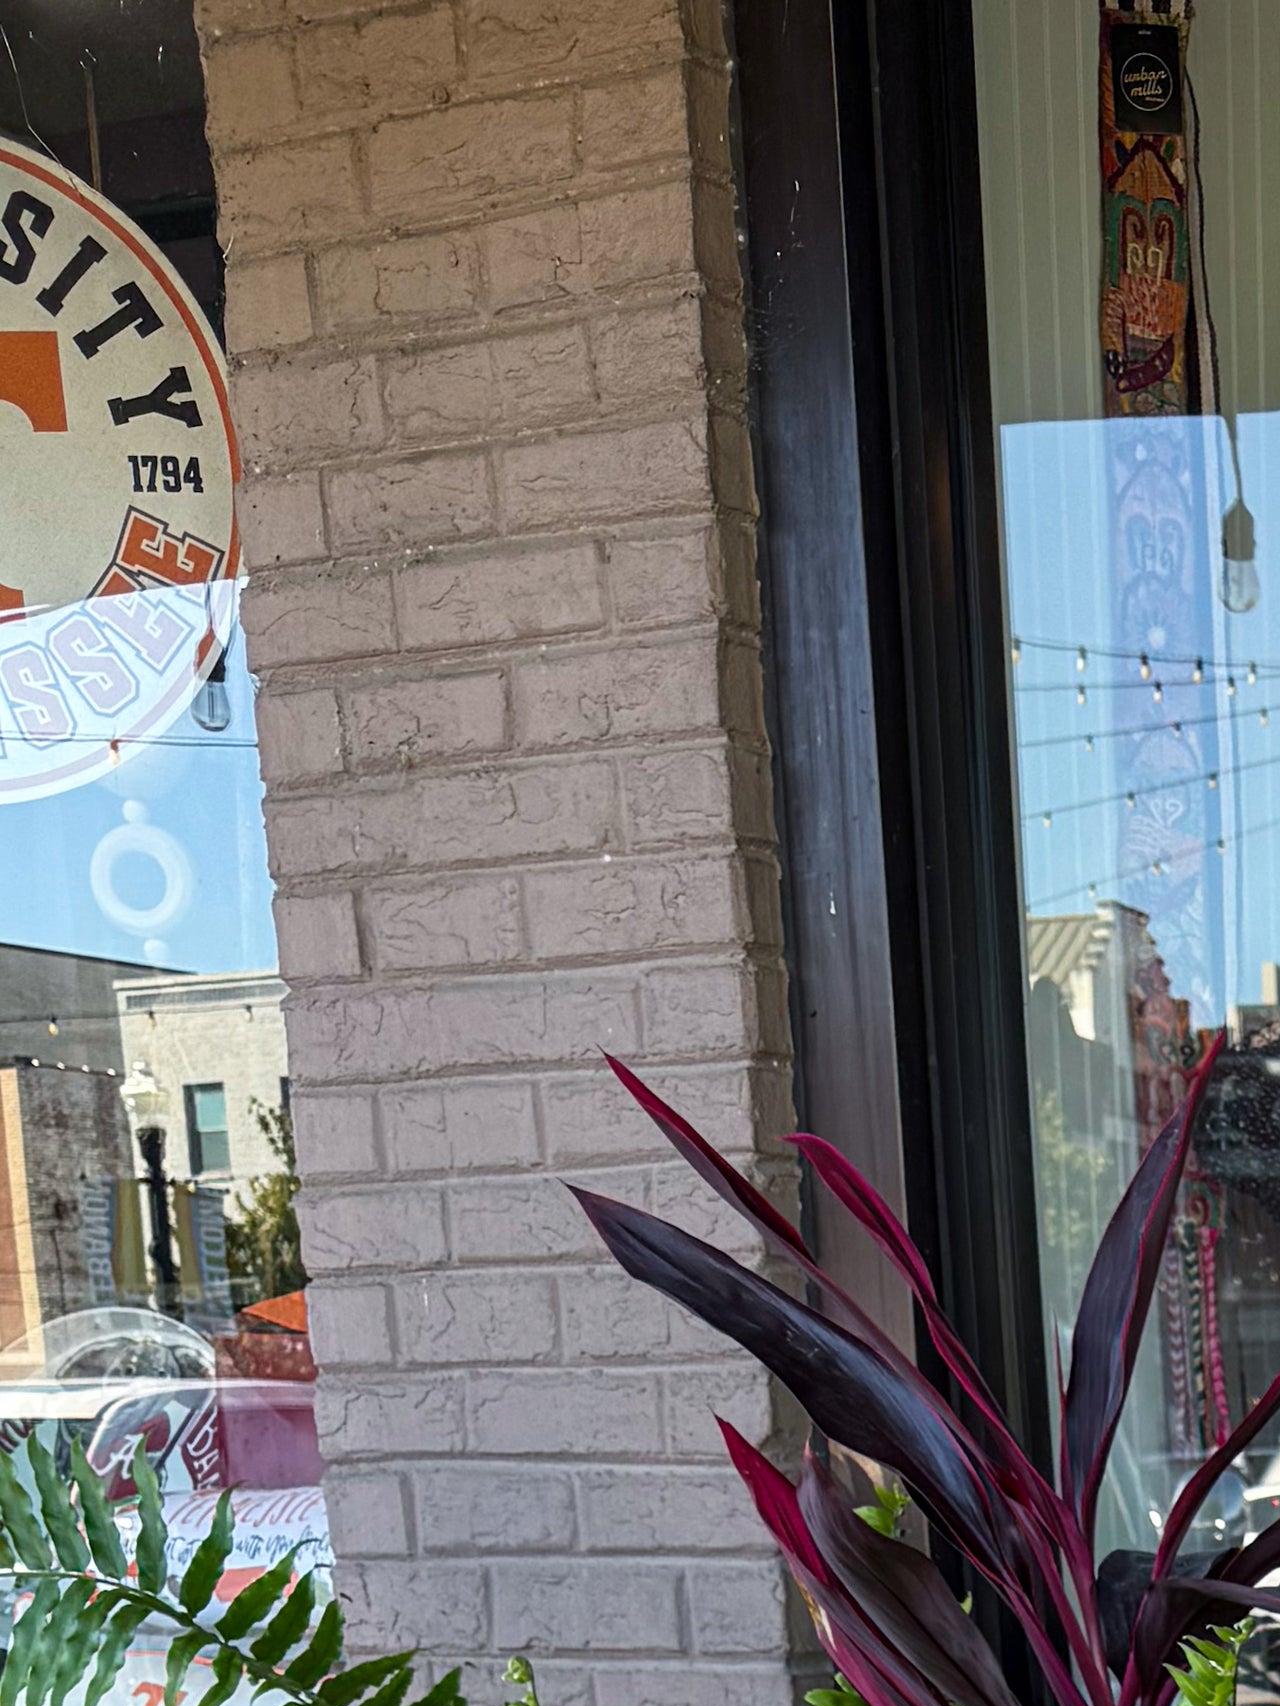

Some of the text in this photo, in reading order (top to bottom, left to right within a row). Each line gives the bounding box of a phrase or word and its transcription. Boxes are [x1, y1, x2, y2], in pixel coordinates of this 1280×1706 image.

[1124, 66, 1167, 83] urban
[1130, 81, 1163, 97] mills
[0, 190, 203, 428] SITY
[127, 455, 203, 493] 1794
[0, 505, 225, 758] SSEE
